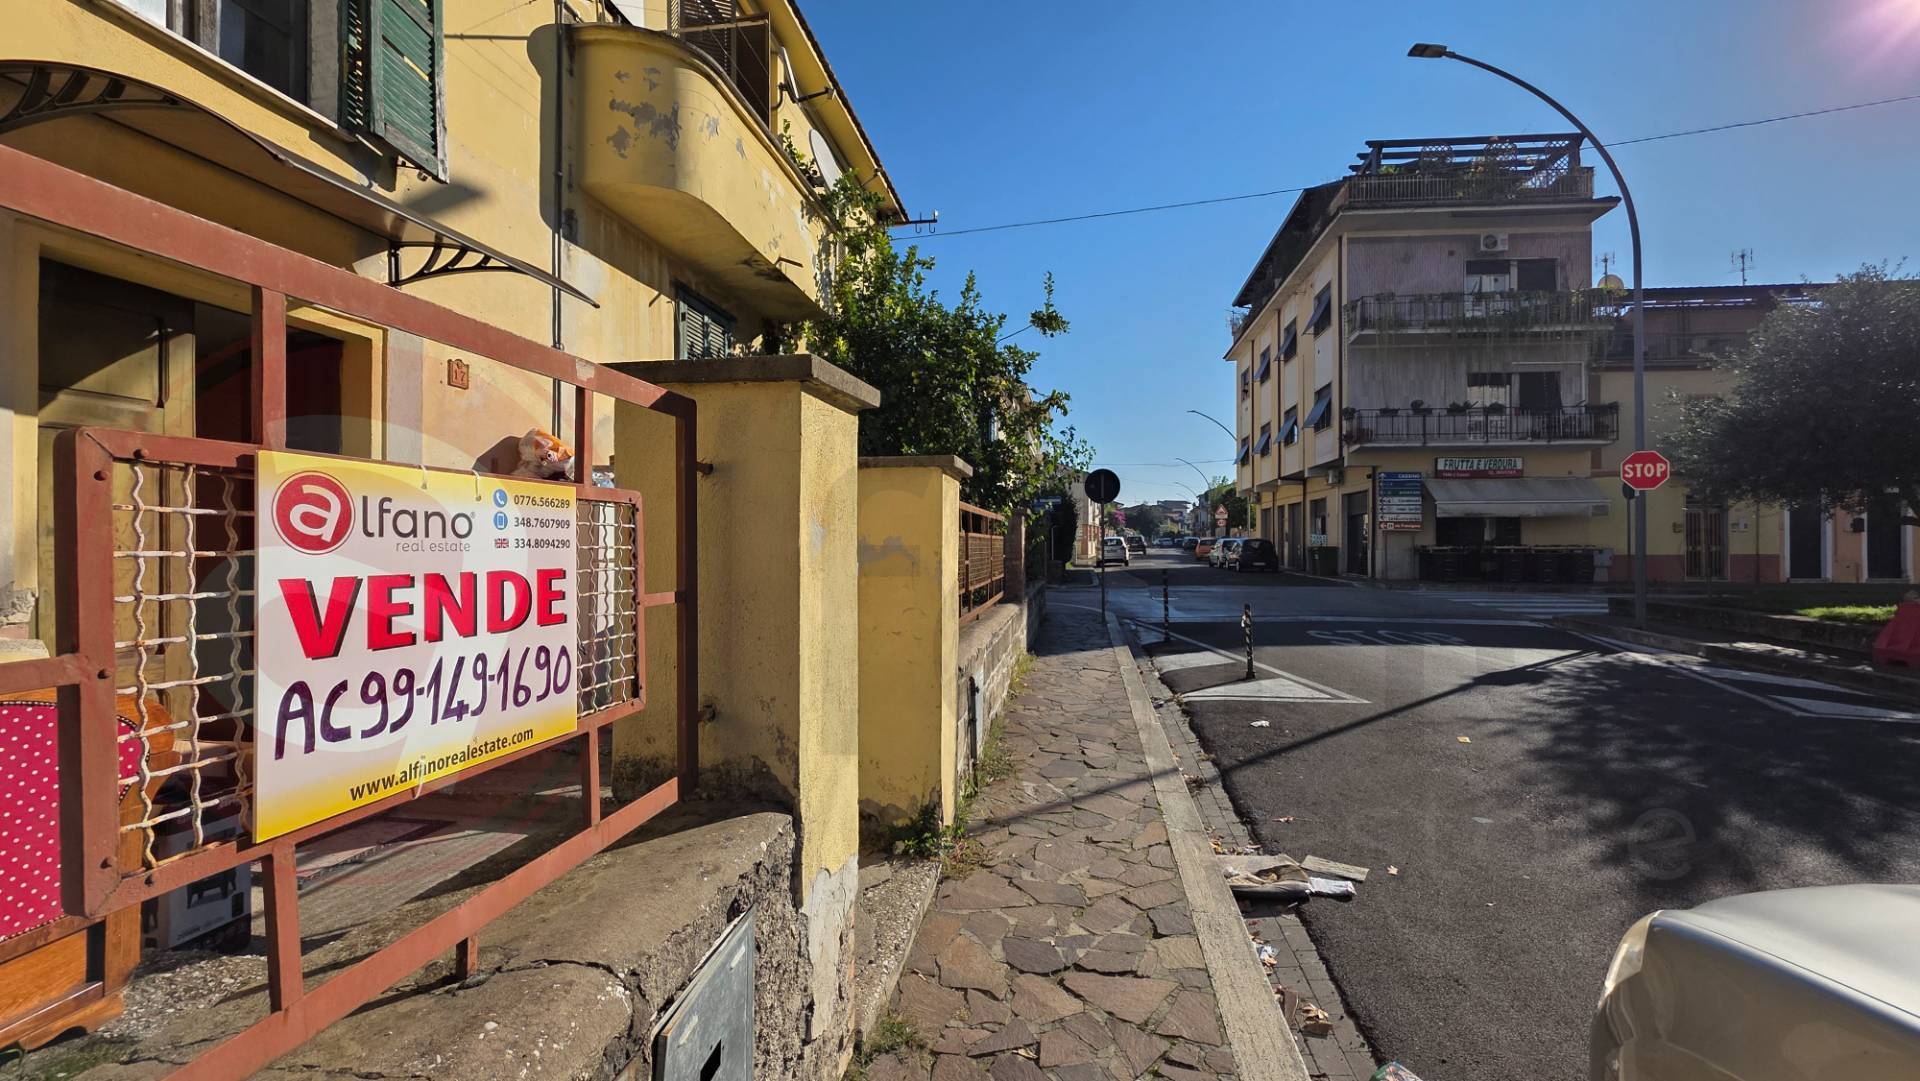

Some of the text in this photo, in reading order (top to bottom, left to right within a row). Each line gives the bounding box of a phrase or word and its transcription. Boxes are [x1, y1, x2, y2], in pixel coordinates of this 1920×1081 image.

[454, 368, 466, 382] 17
[1443, 458, 1518, 470] FRUTTA E VERDURA
[1623, 463, 1667, 478] STOP
[513, 495, 570, 509] 0776.566289
[513, 517, 571, 529] 348.7607909
[396, 539, 471, 552] real estate
[513, 538, 571, 549] 334.8094290
[278, 568, 567, 660] VENDE
[1306, 630, 1470, 647] STOP
